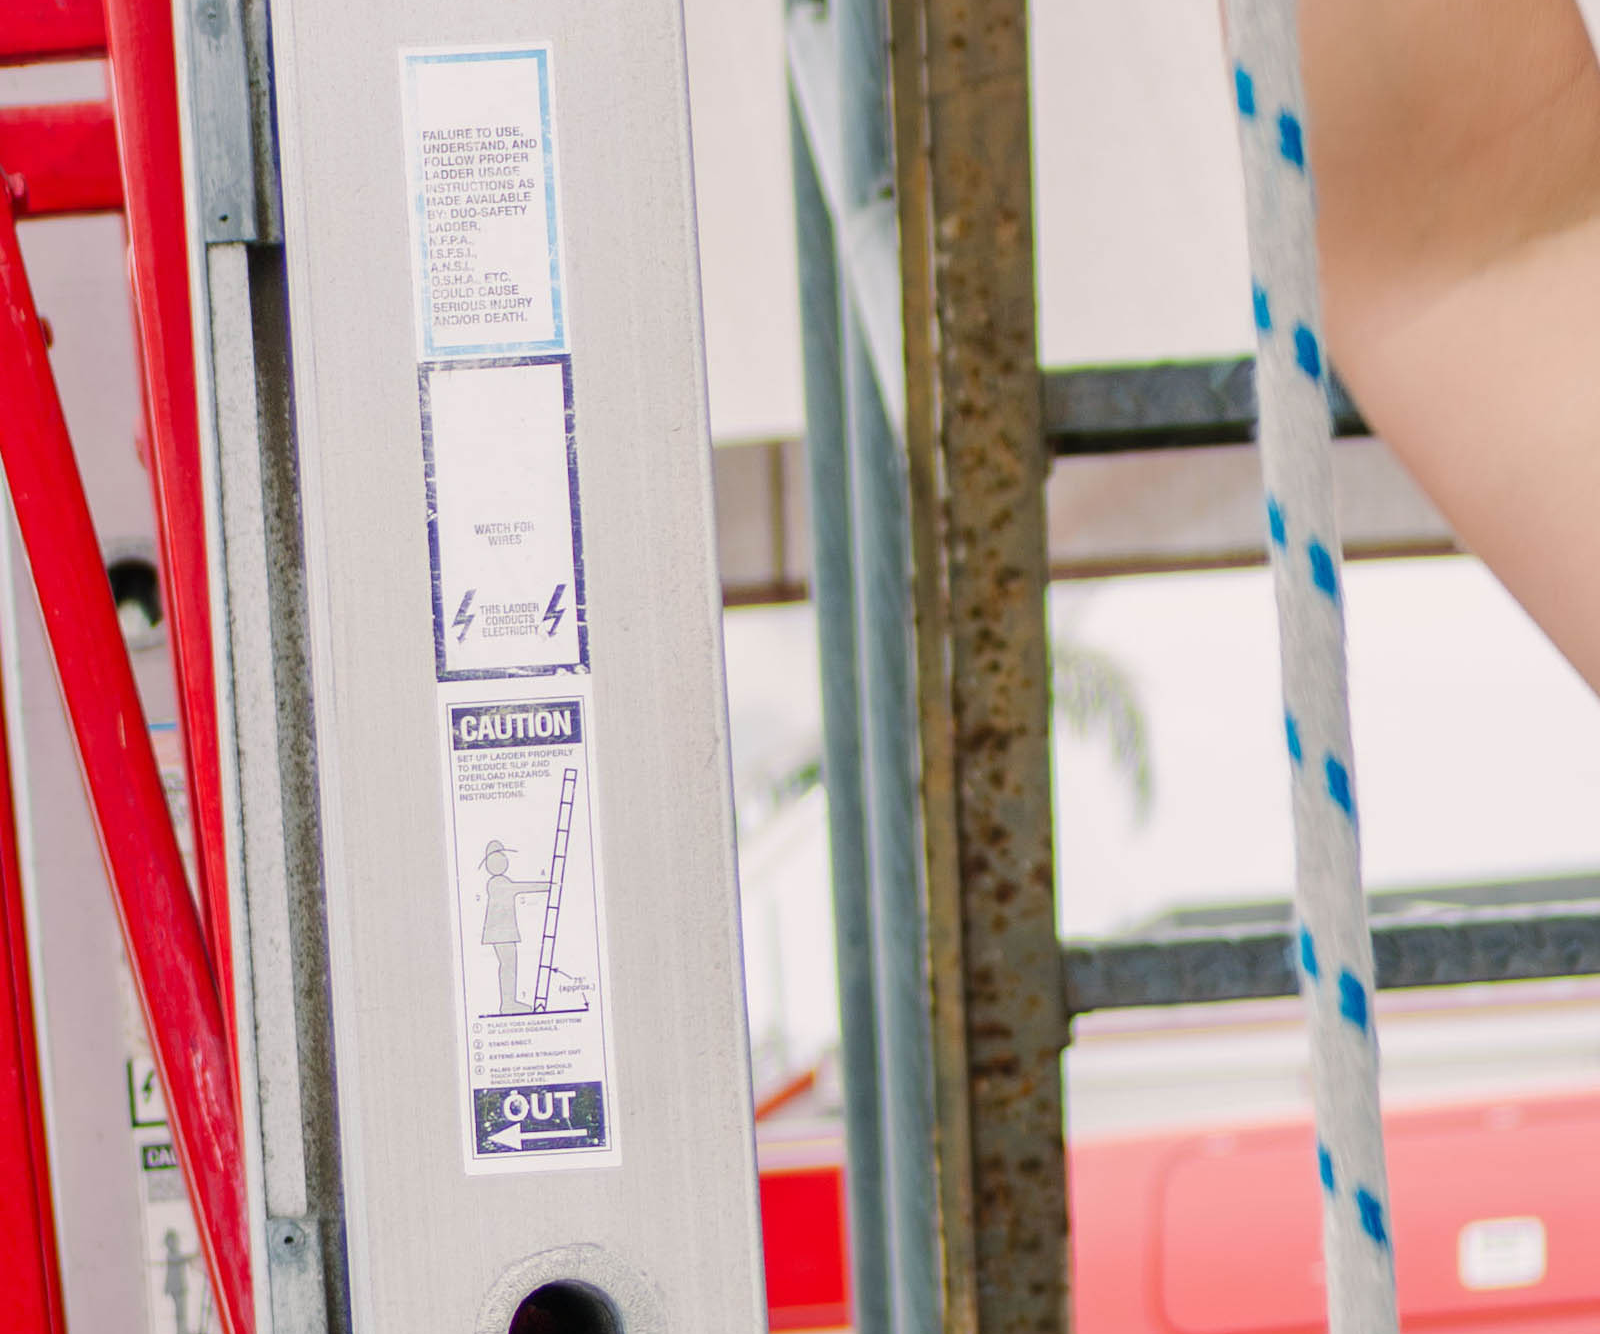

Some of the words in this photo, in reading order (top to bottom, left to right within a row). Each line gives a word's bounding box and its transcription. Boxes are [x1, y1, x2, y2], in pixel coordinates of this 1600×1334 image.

[422, 128, 472, 141] FAILURE
[476, 128, 492, 139] TO
[512, 139, 537, 149] AND
[424, 155, 474, 167] FOLLOW
[480, 152, 528, 163] PROPER
[425, 168, 474, 180] LADDER
[479, 166, 520, 178] USAGE
[426, 179, 514, 194] INSTRUCTIONS
[518, 178, 535, 189] AS
[426, 195, 461, 207] MADE
[465, 192, 532, 205] AVAILABLE
[450, 205, 527, 219] DUO-SAFETY
[432, 287, 474, 299] COULD
[479, 285, 520, 297] CAUSE
[433, 301, 486, 313] SERIOUS
[490, 297, 532, 309] INJURY
[434, 313, 480, 326] AND/OR
[474, 523, 510, 536] WATCH
[514, 521, 534, 534] FOR
[488, 534, 522, 546] WIRES
[480, 604, 501, 615] THIS
[503, 603, 540, 614] LADDER
[486, 614, 536, 625] CONDUCTS
[482, 625, 539, 637] ELECTRICITY
[460, 710, 572, 742] CAUTION
[457, 754, 474, 763] SET
[476, 753, 488, 762] UP
[490, 750, 526, 762] LADDER
[528, 748, 574, 759] PROPERLY
[458, 763, 470, 773] TO
[472, 761, 508, 771] REDUCE
[530, 759, 550, 767] AND
[458, 771, 506, 782] OVERLOAD
[458, 782, 496, 792] FOLLOW
[498, 780, 526, 789] THESE
[558, 983, 596, 995] (approx.)
[504, 1091, 576, 1121] OUT
